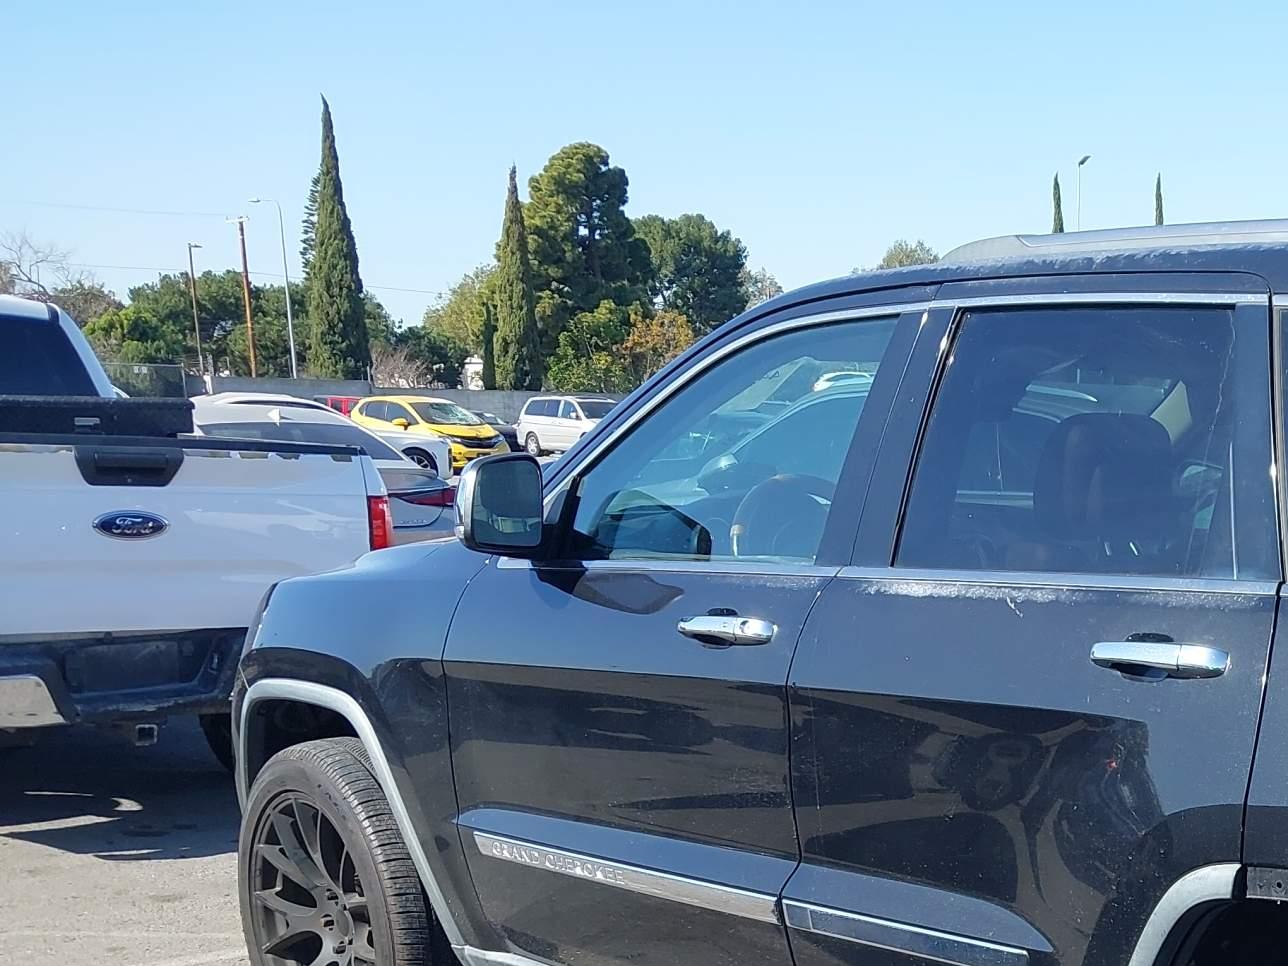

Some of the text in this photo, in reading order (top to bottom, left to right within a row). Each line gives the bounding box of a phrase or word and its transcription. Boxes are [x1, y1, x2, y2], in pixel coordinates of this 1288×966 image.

[111, 516, 154, 535] Ford
[491, 841, 626, 885] GRAND CHEROKEE
